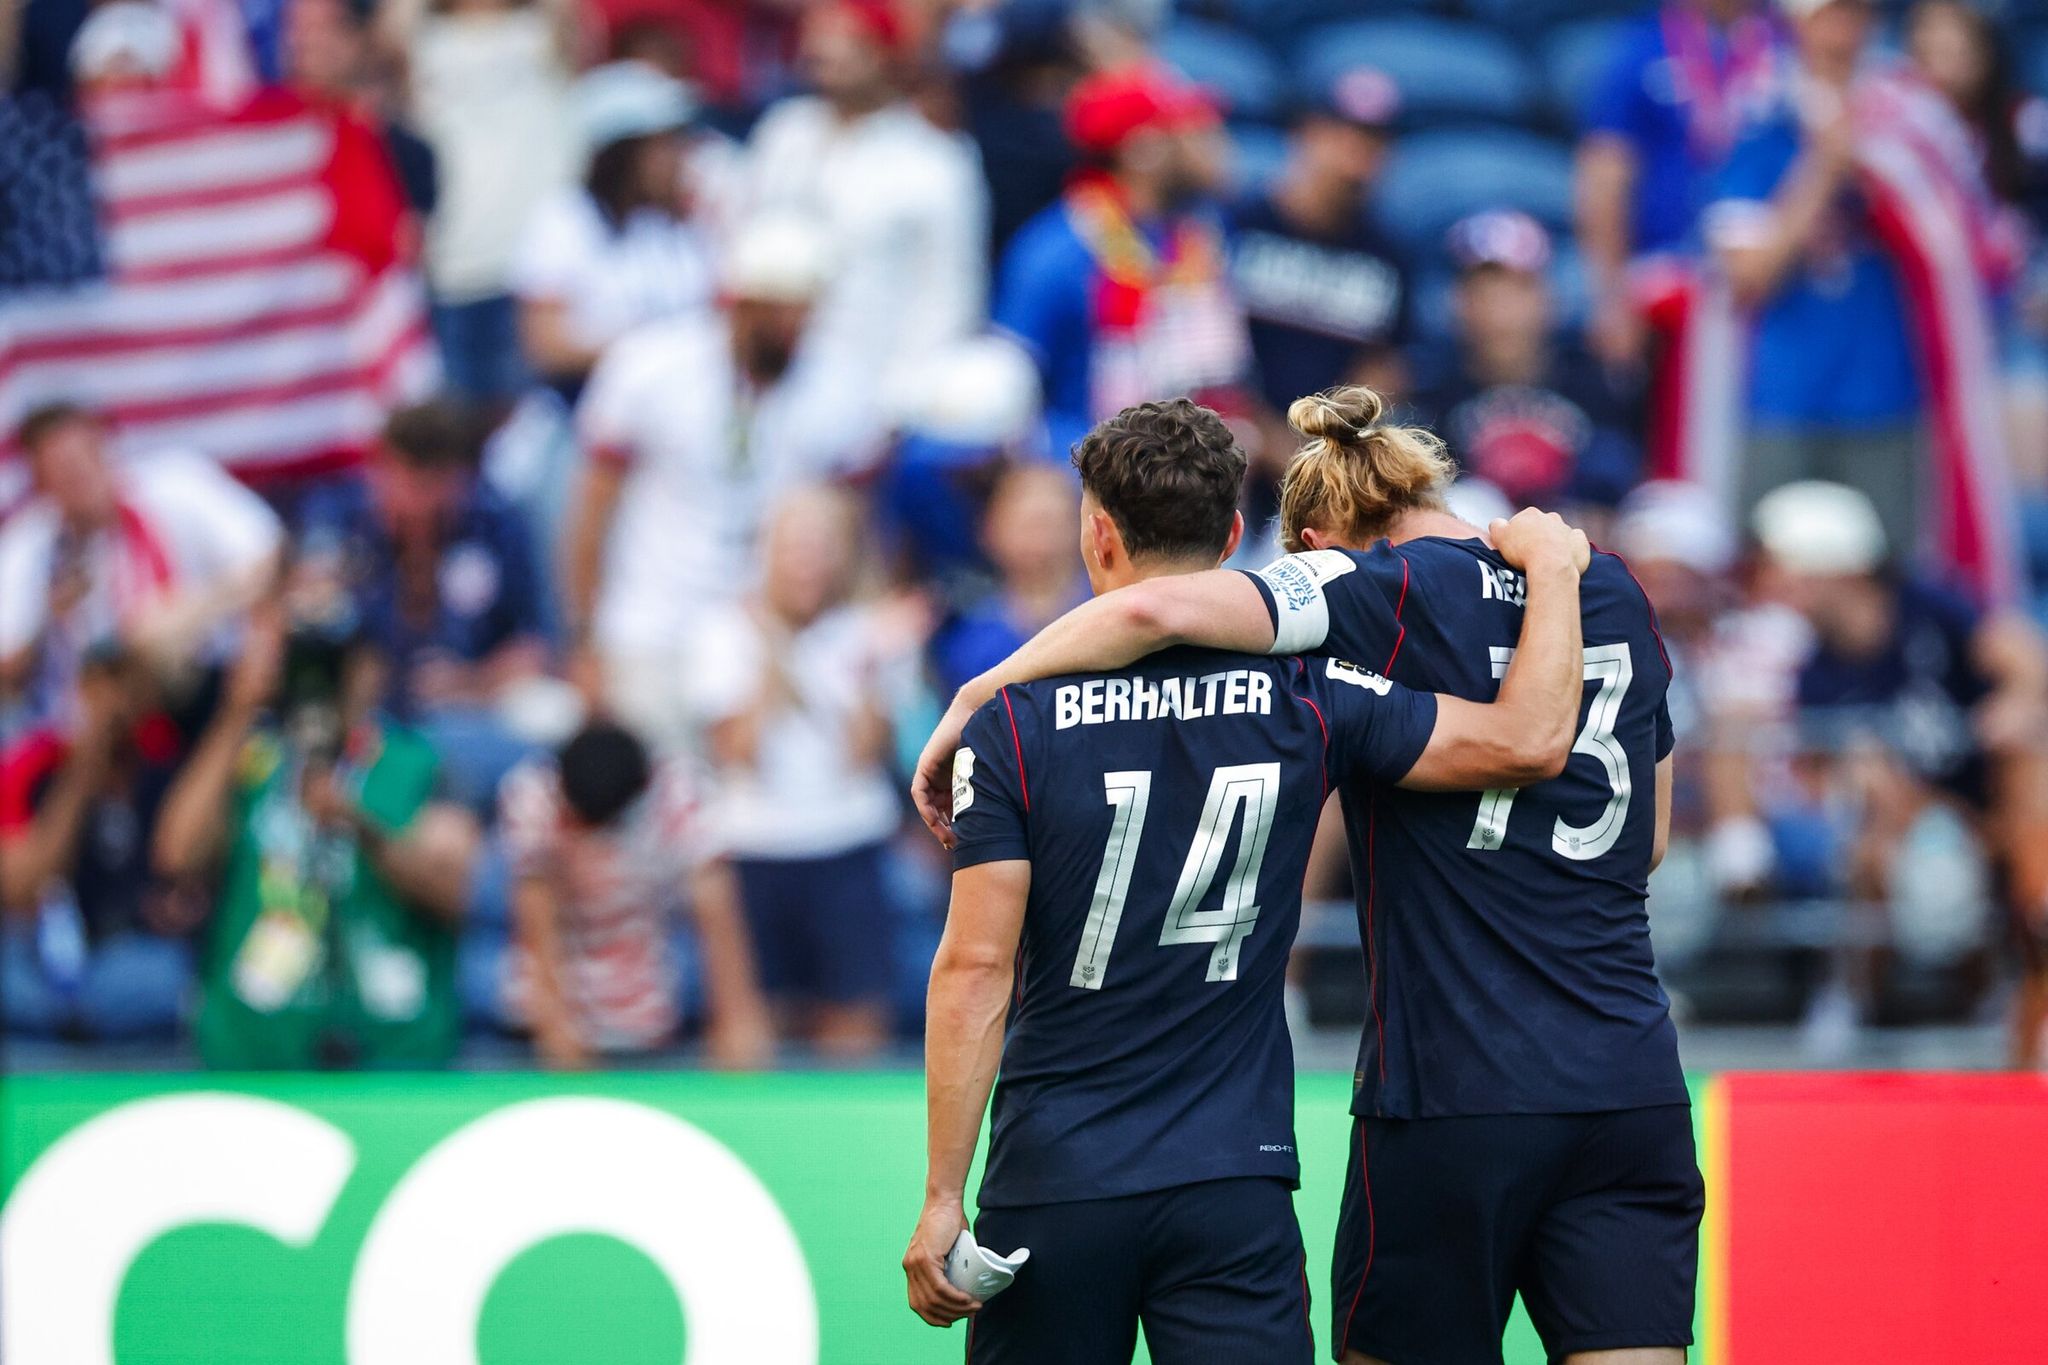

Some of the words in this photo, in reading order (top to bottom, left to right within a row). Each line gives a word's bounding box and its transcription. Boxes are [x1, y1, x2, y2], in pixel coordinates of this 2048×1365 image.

[1268, 566, 1310, 606] UNITES
[1279, 561, 1317, 602] FOOTBALL
[1055, 669, 1273, 730] BERHALTER
[1069, 761, 1281, 990] 14
